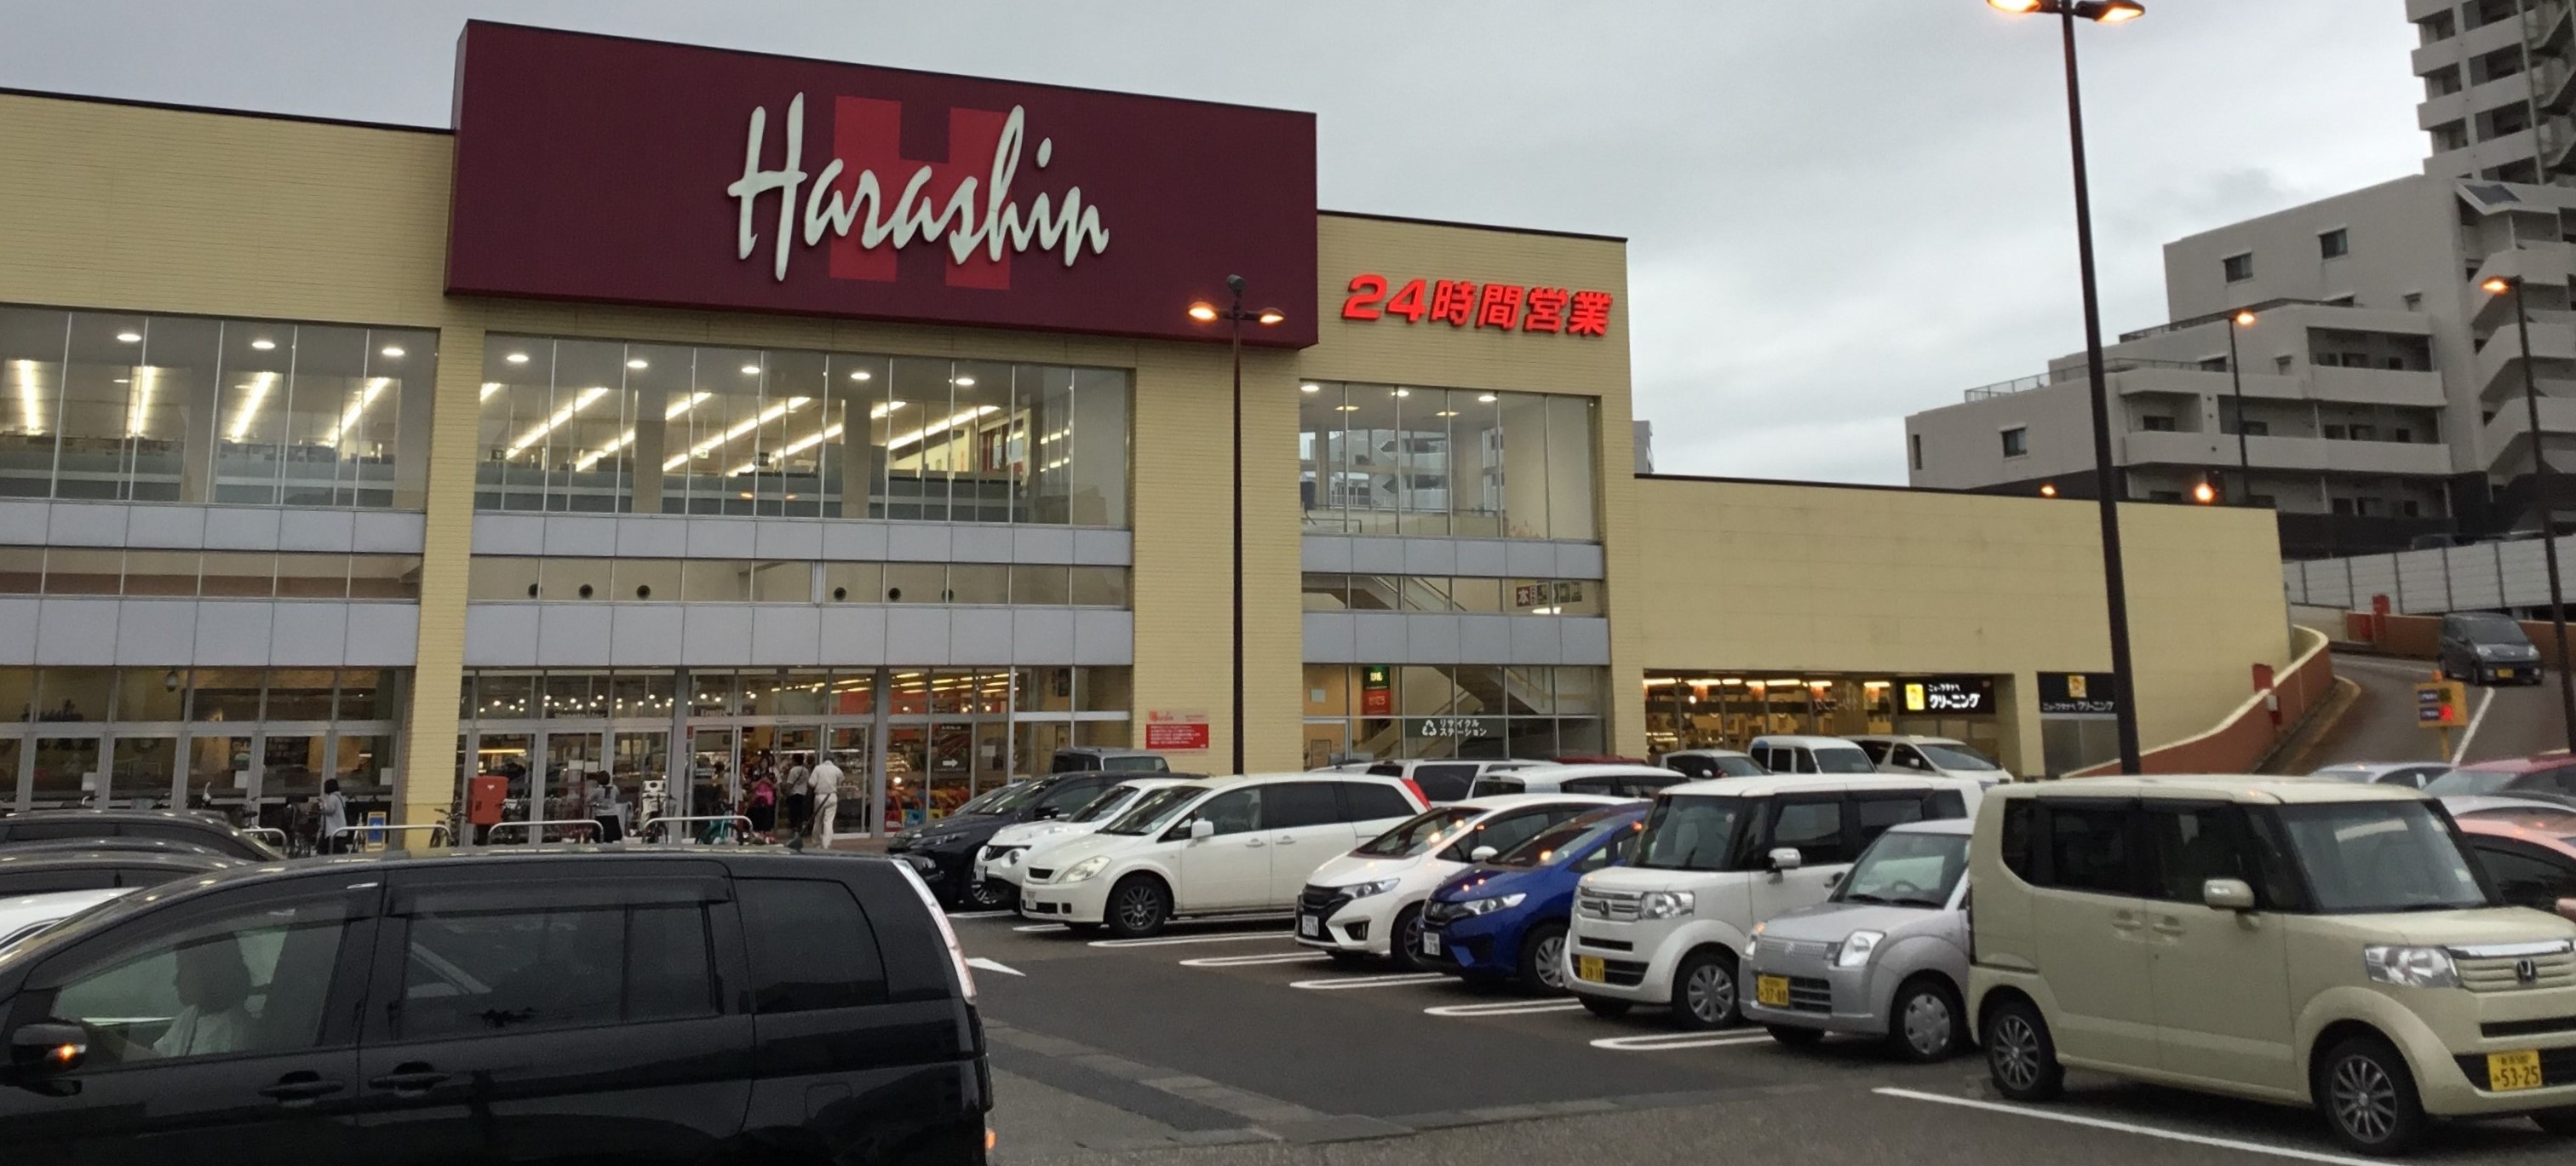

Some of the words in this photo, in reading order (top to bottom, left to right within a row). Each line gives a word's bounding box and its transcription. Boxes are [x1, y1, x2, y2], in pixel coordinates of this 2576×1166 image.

[727, 91, 1110, 282] Harashin
[1341, 273, 1614, 338] 24時間営業
[1929, 693, 1981, 709] クリーニング
[1439, 719, 1480, 728] リサイクル
[1439, 727, 1488, 738] ステーション
[2500, 1065, 2539, 1088] 53-25
